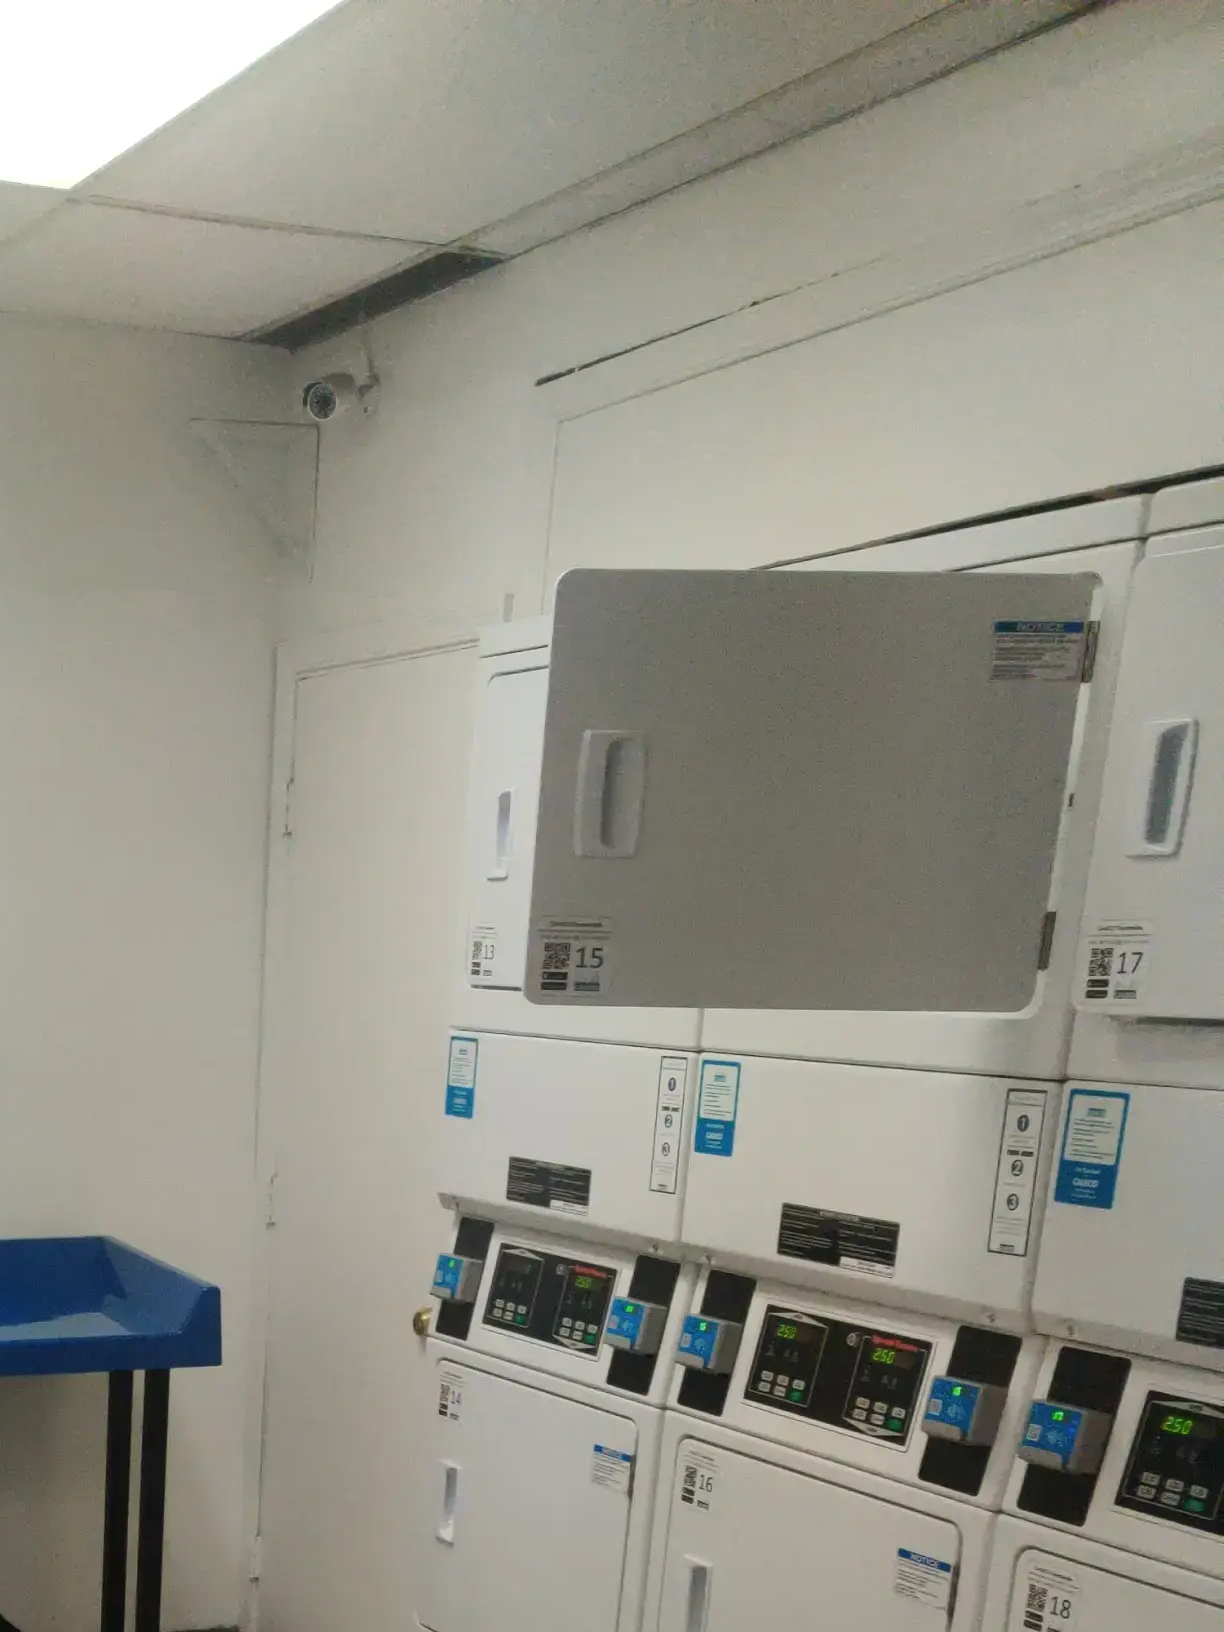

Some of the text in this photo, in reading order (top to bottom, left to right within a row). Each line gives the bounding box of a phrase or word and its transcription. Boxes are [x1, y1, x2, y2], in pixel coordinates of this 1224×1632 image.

[575, 946, 605, 969] 15
[1116, 951, 1145, 974] 17
[698, 1474, 714, 1493] 16
[1050, 1596, 1072, 1619] 18
